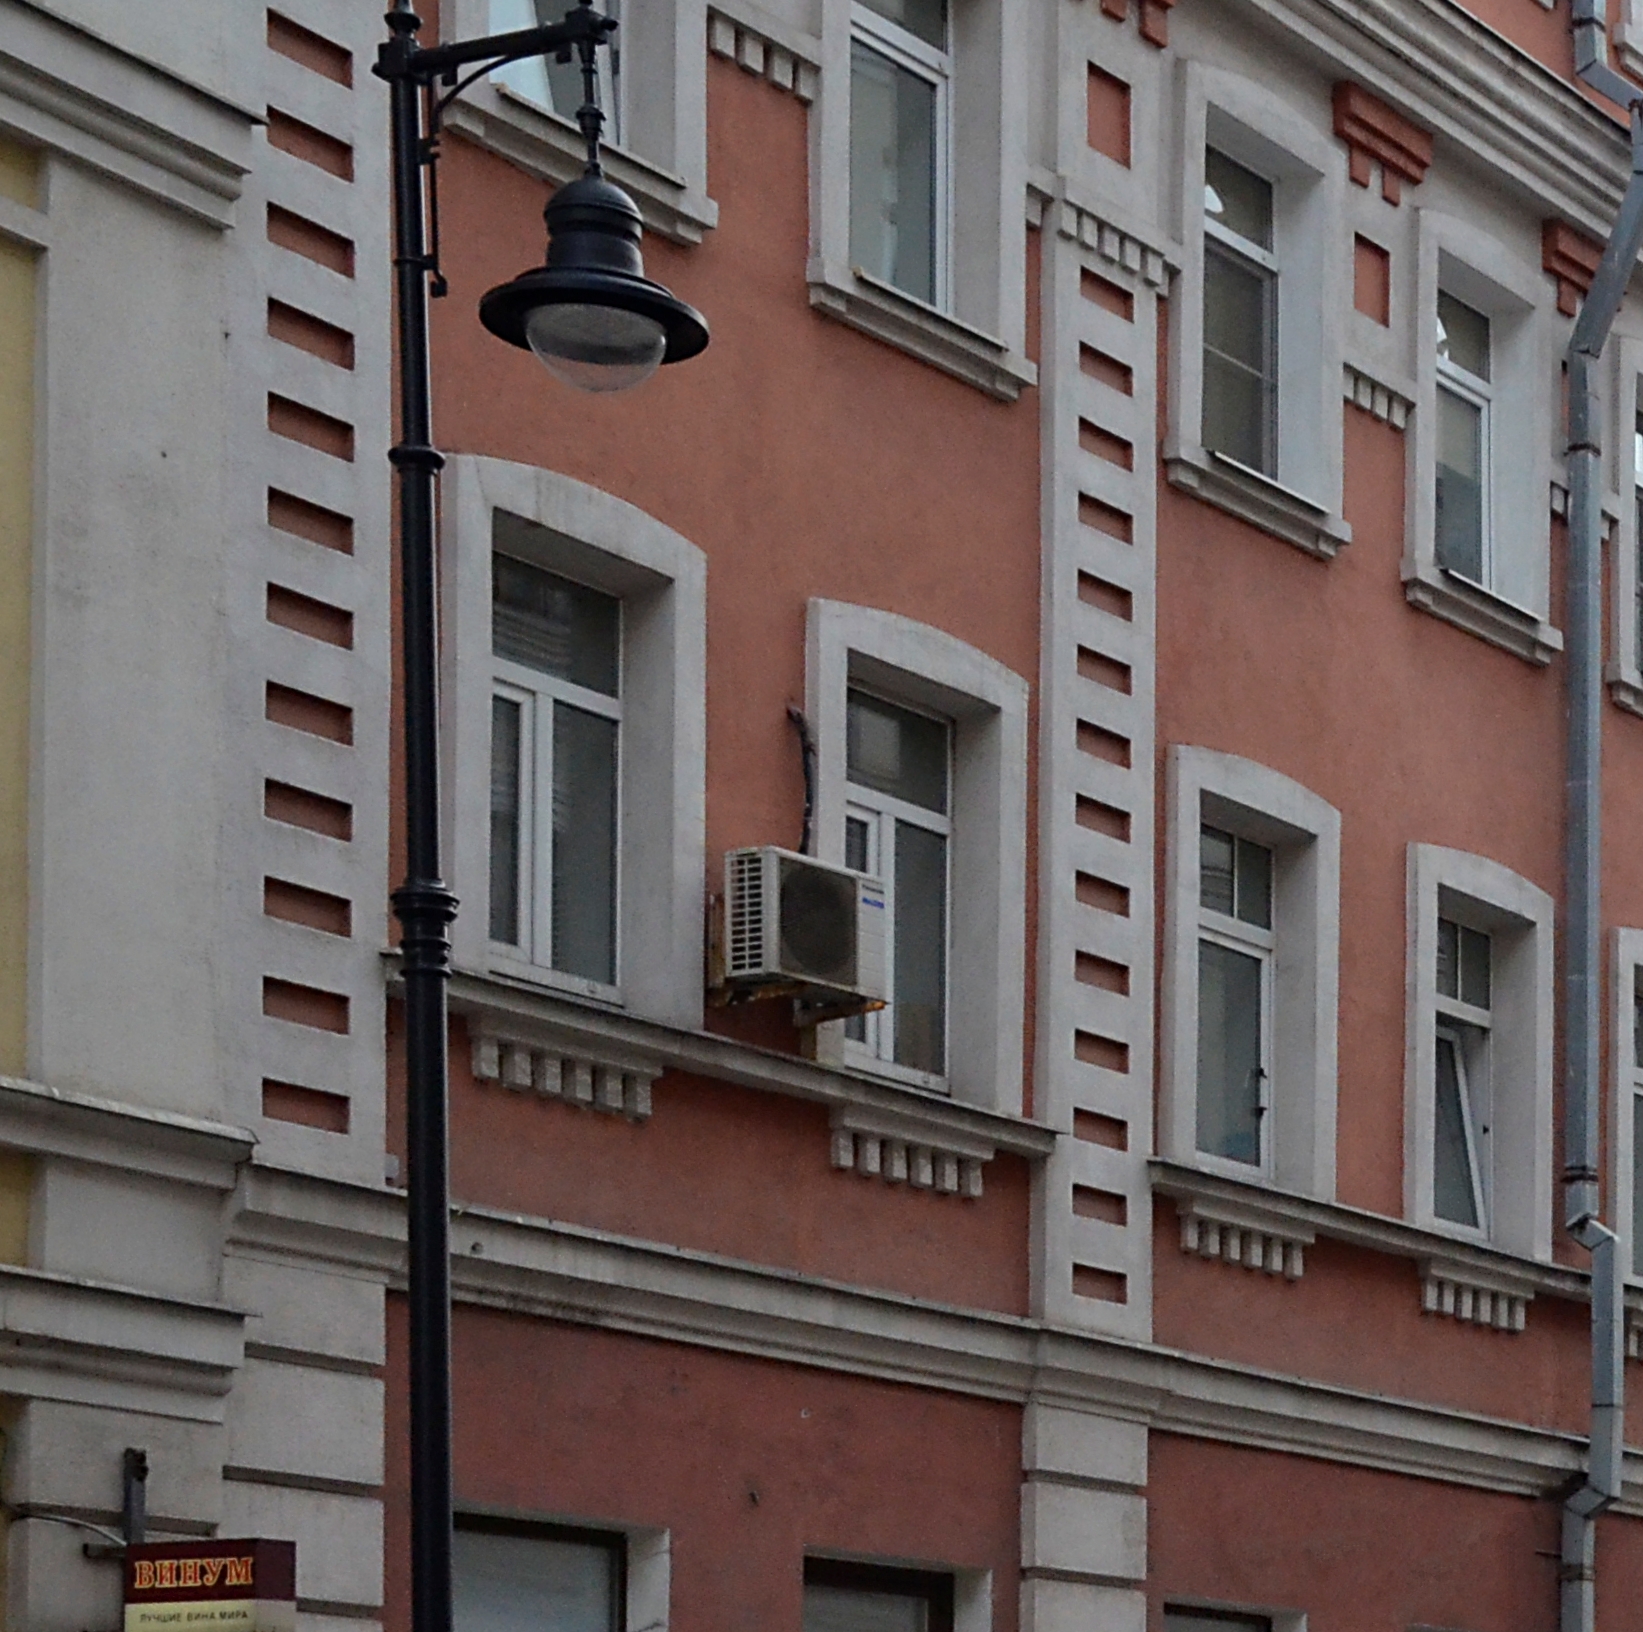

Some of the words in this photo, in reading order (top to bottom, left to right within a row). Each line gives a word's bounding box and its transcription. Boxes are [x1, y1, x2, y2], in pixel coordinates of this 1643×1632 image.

[134, 1556, 254, 1589] ВИНУМ
[139, 1613, 183, 1623] ЛУЧШИЕ
[186, 1611, 215, 1622] ВИНА
[218, 1610, 249, 1621] МИРА
